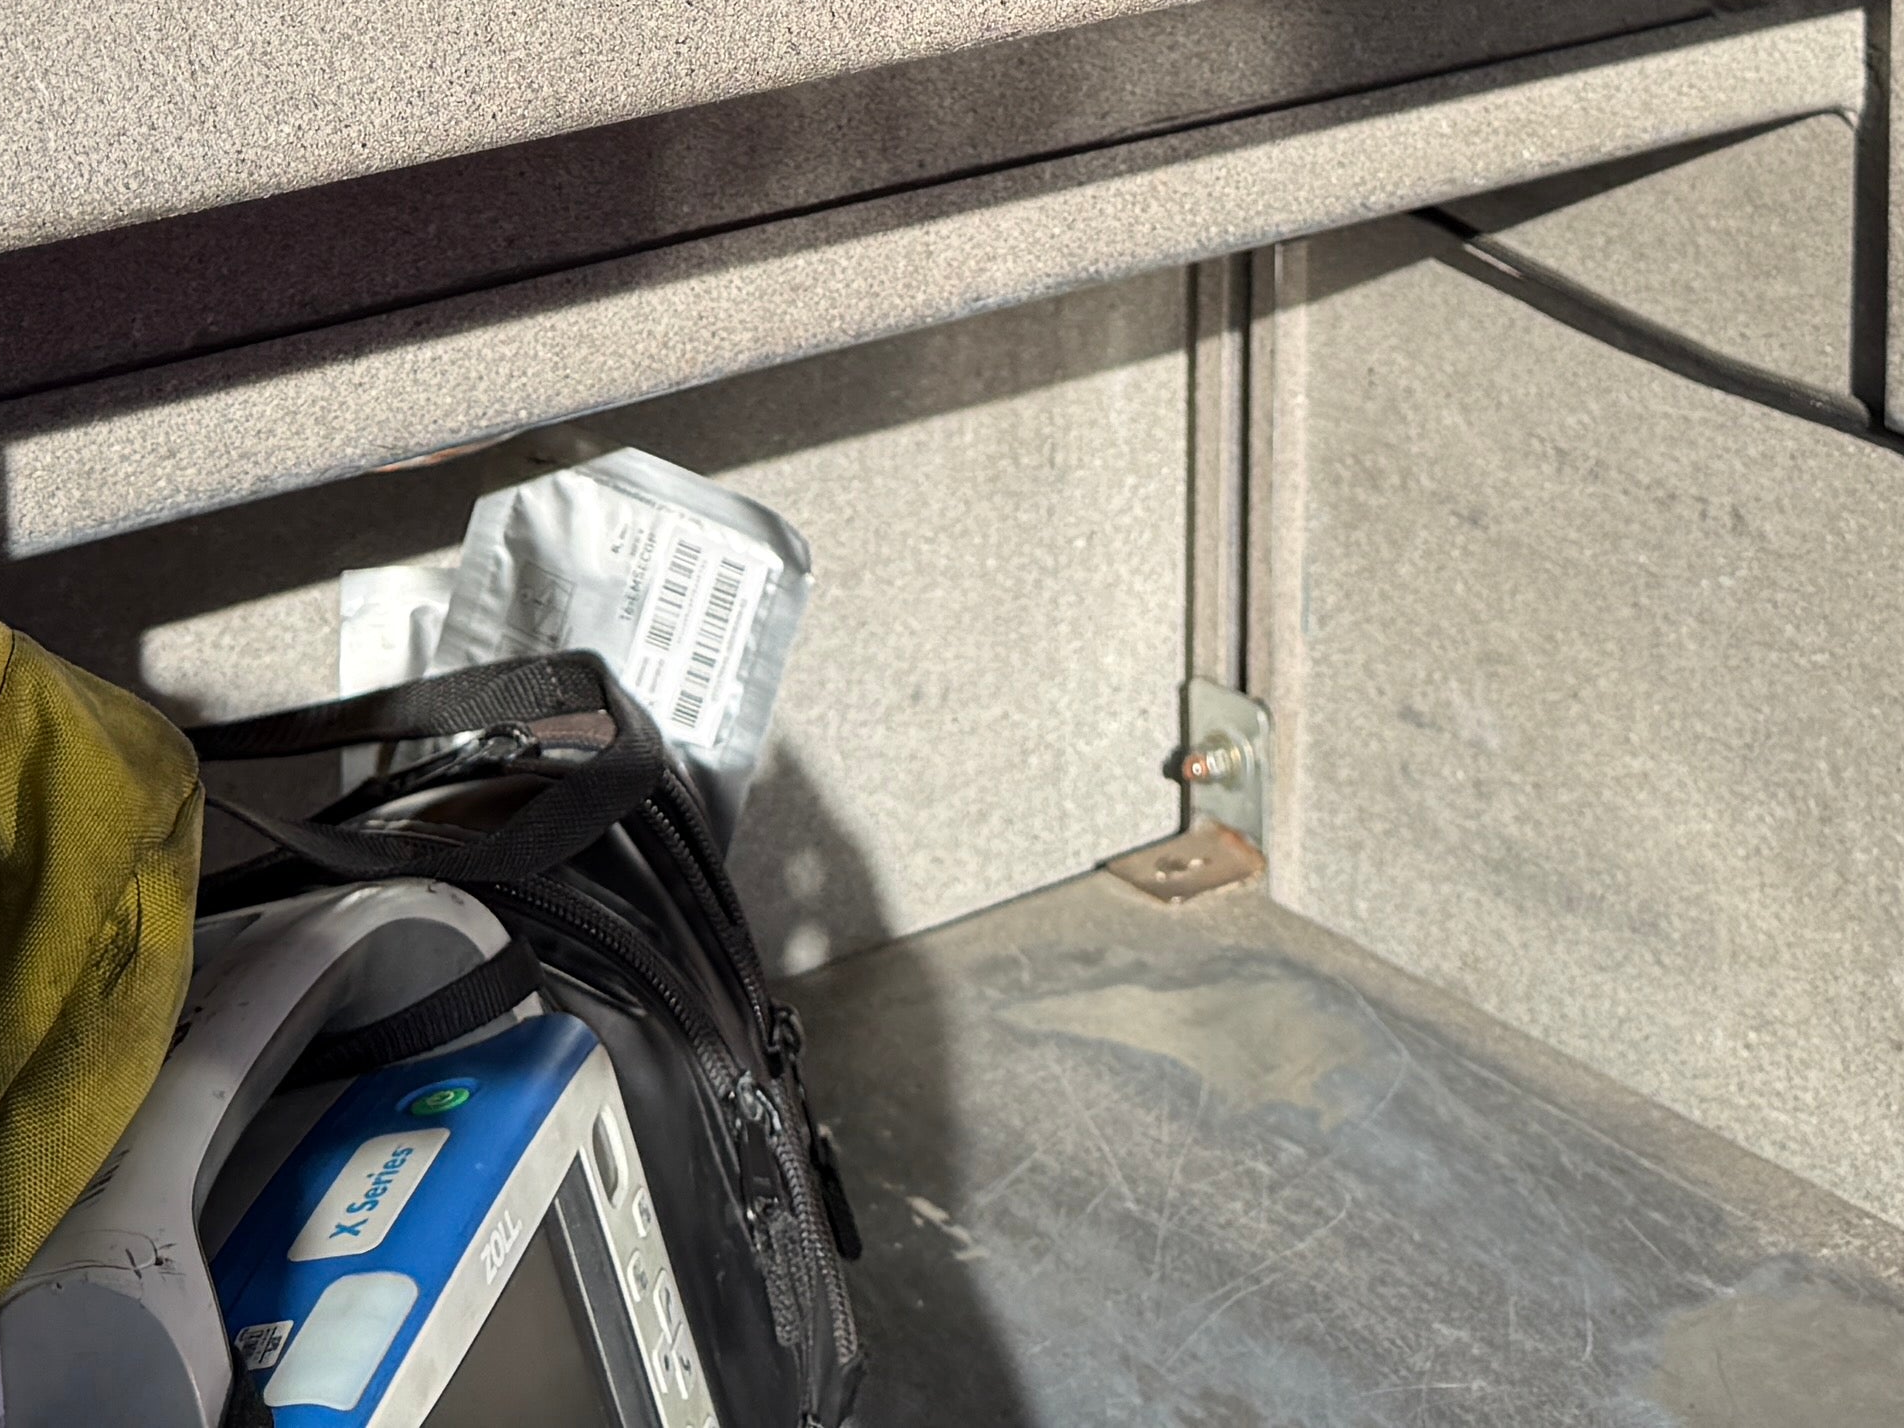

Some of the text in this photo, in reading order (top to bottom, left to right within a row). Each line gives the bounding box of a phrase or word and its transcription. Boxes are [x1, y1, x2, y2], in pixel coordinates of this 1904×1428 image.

[329, 1146, 414, 1239] X Series
[480, 1209, 523, 1285] ZOLL
